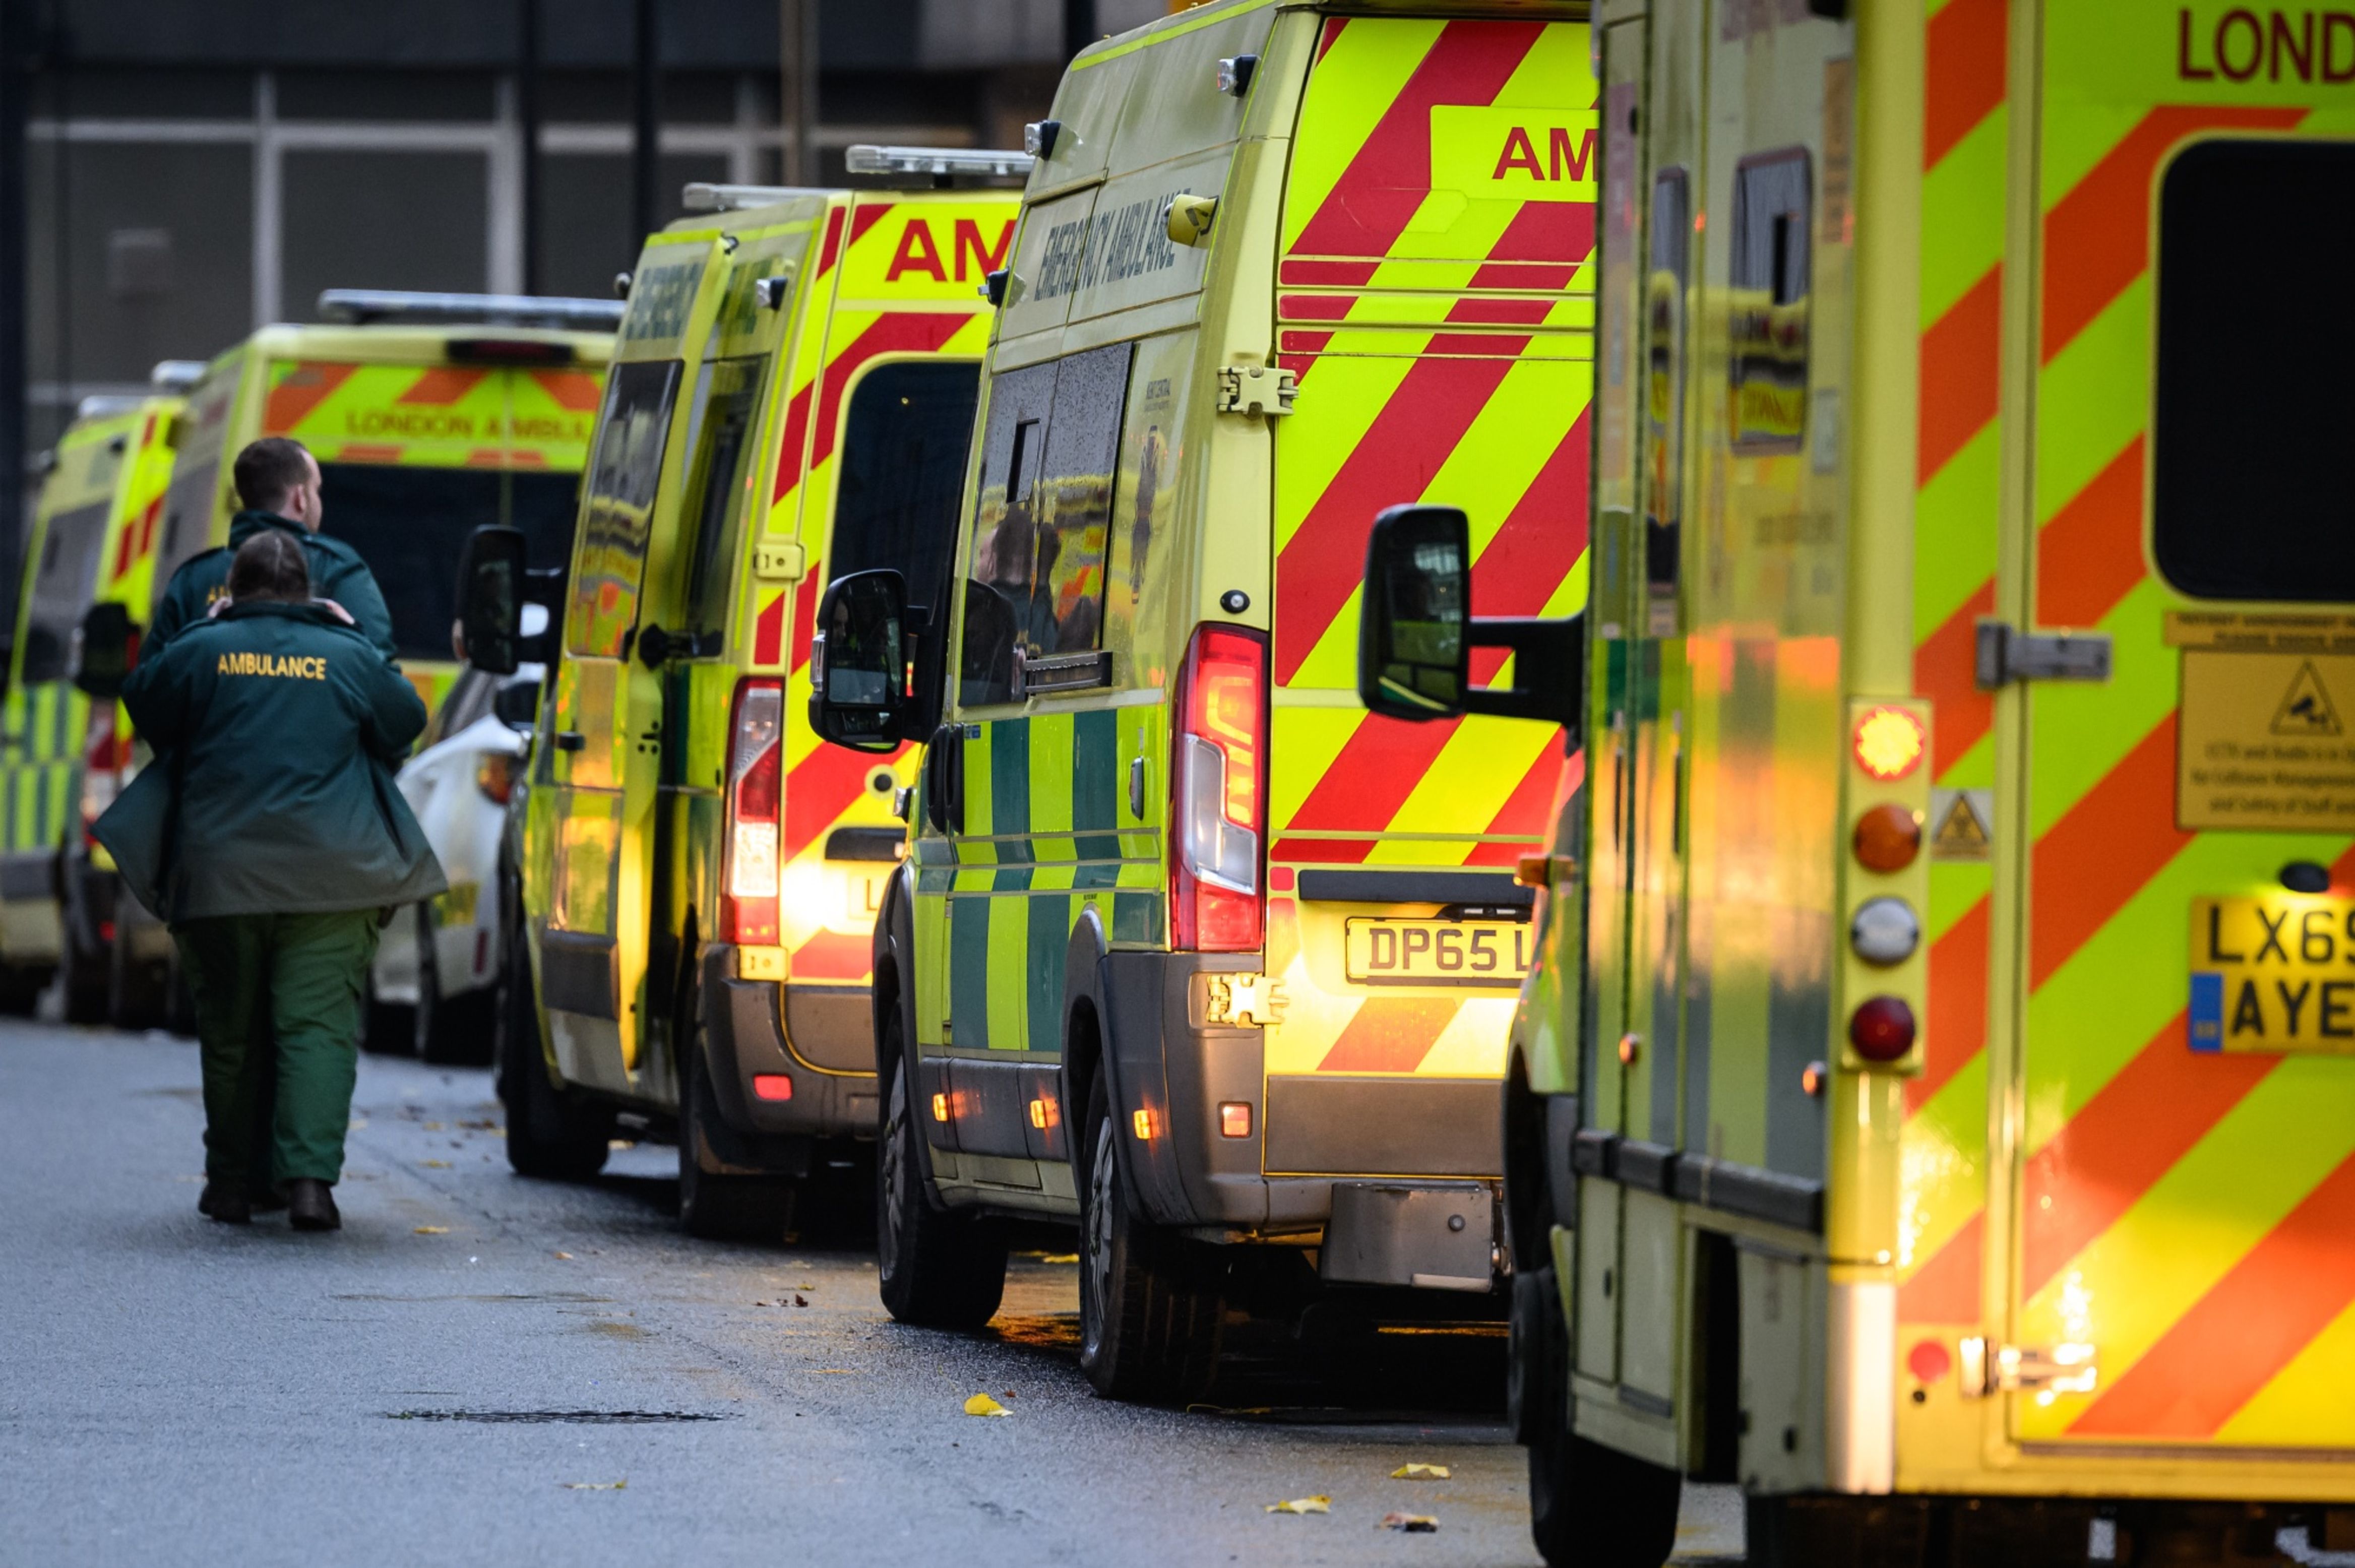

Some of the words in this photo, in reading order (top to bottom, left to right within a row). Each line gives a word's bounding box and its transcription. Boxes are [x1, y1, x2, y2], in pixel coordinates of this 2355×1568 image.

[2179, 7, 2355, 84] LOND
[1492, 127, 1598, 182] AM
[1034, 209, 1117, 301] EMERGENCY
[345, 410, 474, 437] LONDON
[218, 652, 326, 680] AMBULANCE
[1369, 928, 1497, 971] DP65
[2232, 980, 2355, 1037] AYE
